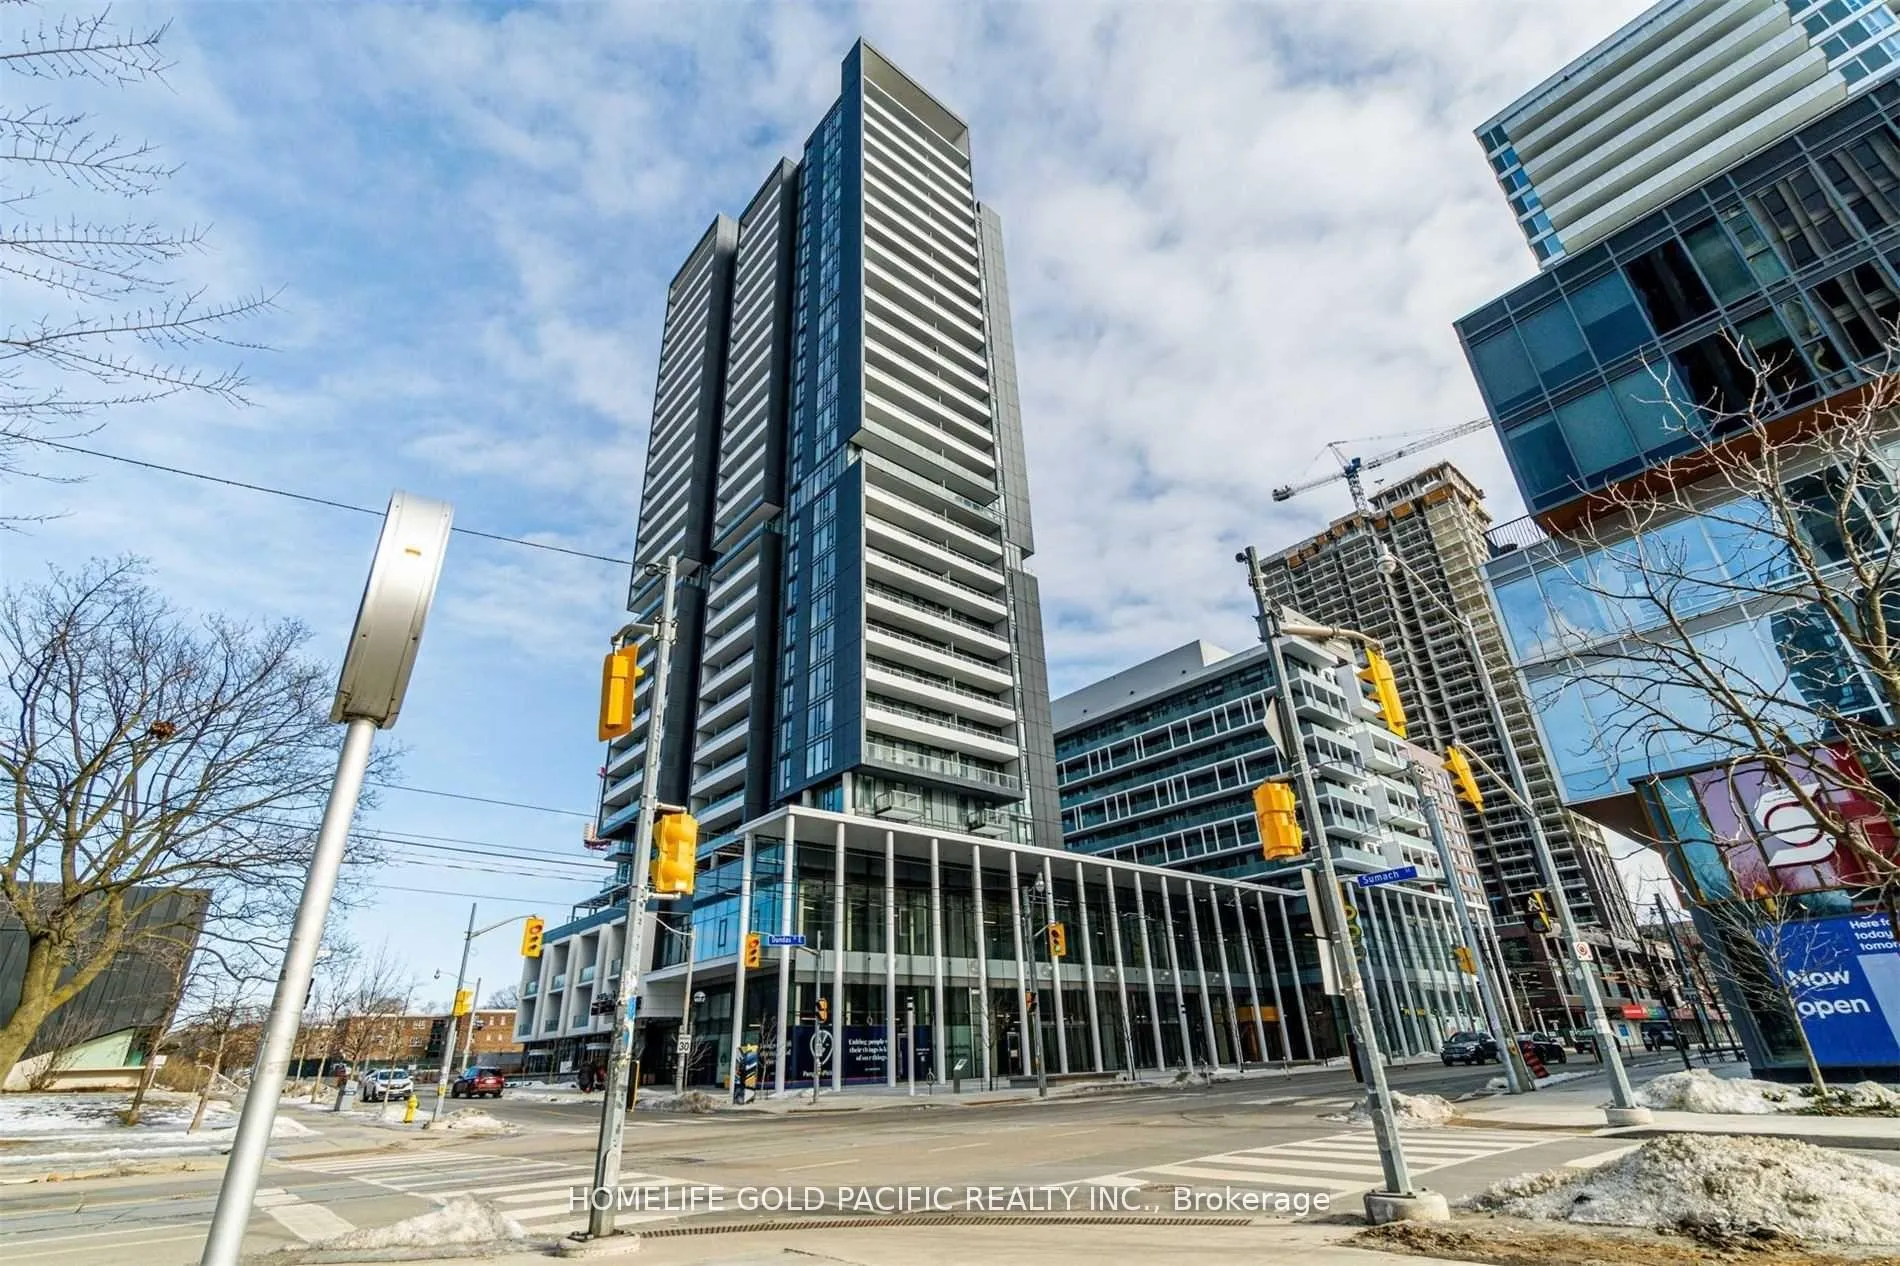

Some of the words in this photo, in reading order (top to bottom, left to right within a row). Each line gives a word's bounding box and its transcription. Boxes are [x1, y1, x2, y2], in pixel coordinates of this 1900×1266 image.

[1362, 871, 1400, 885] Sumach
[1849, 920, 1880, 929] Here
[771, 935, 791, 944] Dundas
[1854, 930, 1894, 940] today
[1787, 970, 1850, 989] Now
[1798, 998, 1871, 1019] open
[679, 1041, 690, 1051] 30
